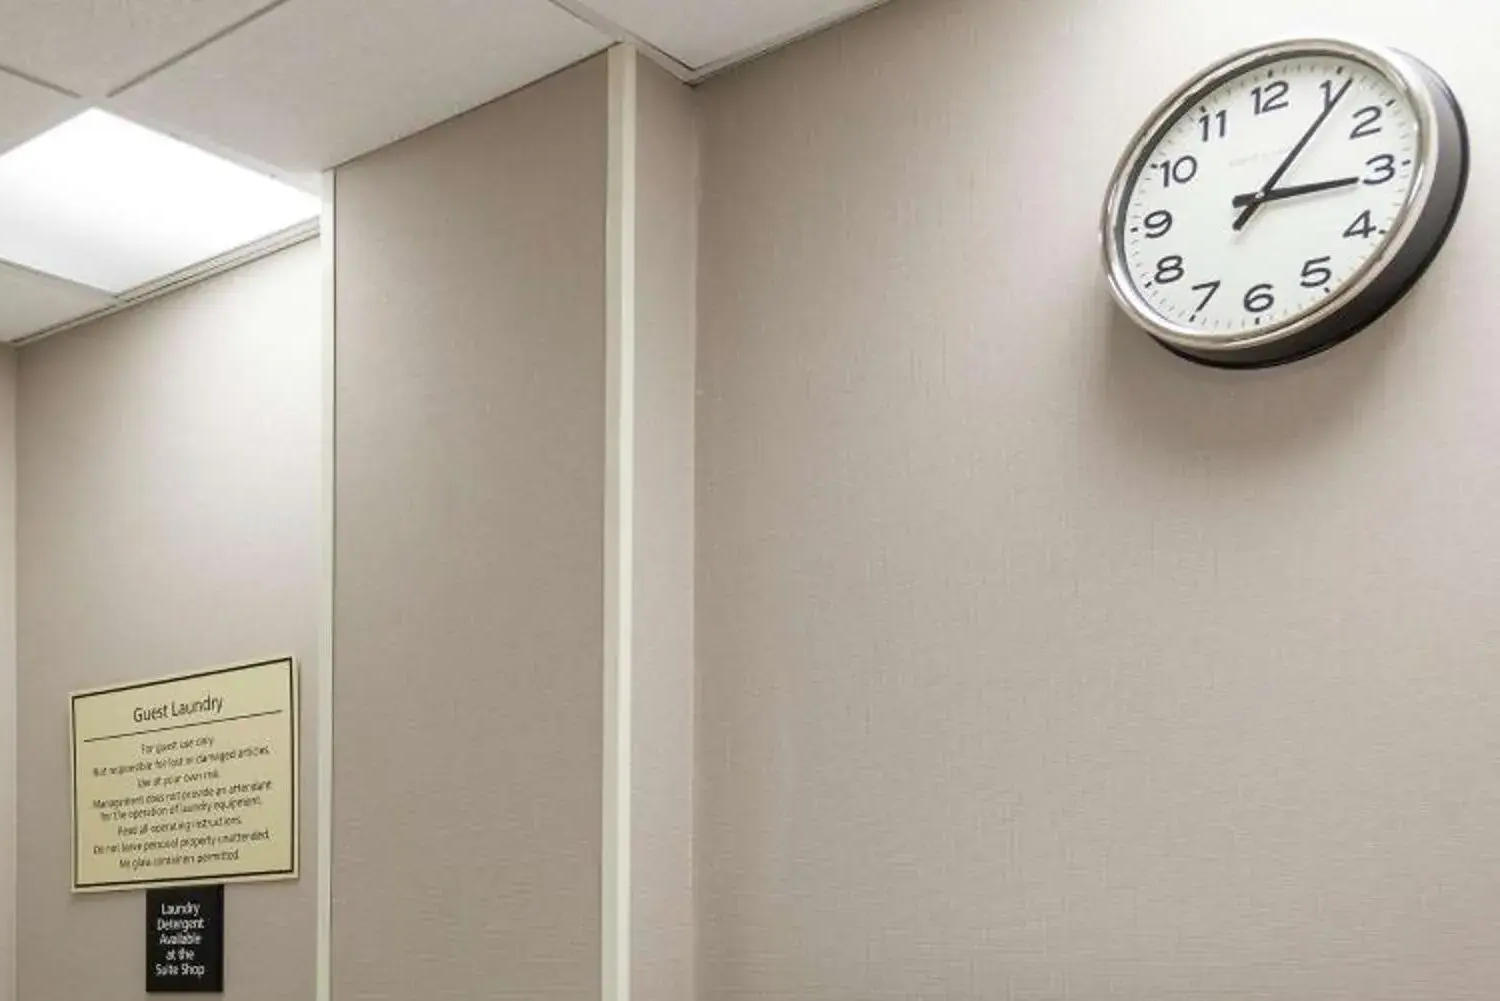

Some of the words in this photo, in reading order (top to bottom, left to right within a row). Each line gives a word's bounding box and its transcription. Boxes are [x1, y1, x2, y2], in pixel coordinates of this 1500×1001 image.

[1252, 80, 1290, 115] 12
[1319, 79, 1333, 112] 1
[1200, 109, 1228, 142] 11
[1348, 105, 1384, 140] 2
[1159, 154, 1199, 188] 10
[1361, 153, 1397, 186] 3
[1143, 209, 1173, 239] 9
[1341, 210, 1377, 240] 4
[1153, 255, 1185, 285] 8
[1299, 256, 1333, 288] 5
[1191, 280, 1222, 314] 7
[1242, 283, 1276, 313] 6
[133, 704, 168, 723] Guest
[171, 693, 223, 716] Laundry
[161, 902, 201, 917] Laundry
[157, 918, 205, 932] Detergent
[159, 932, 202, 945] Available
[165, 950, 176, 960] at
[178, 948, 195, 960] the
[155, 963, 179, 976] Suite
[181, 963, 205, 979] Shop
